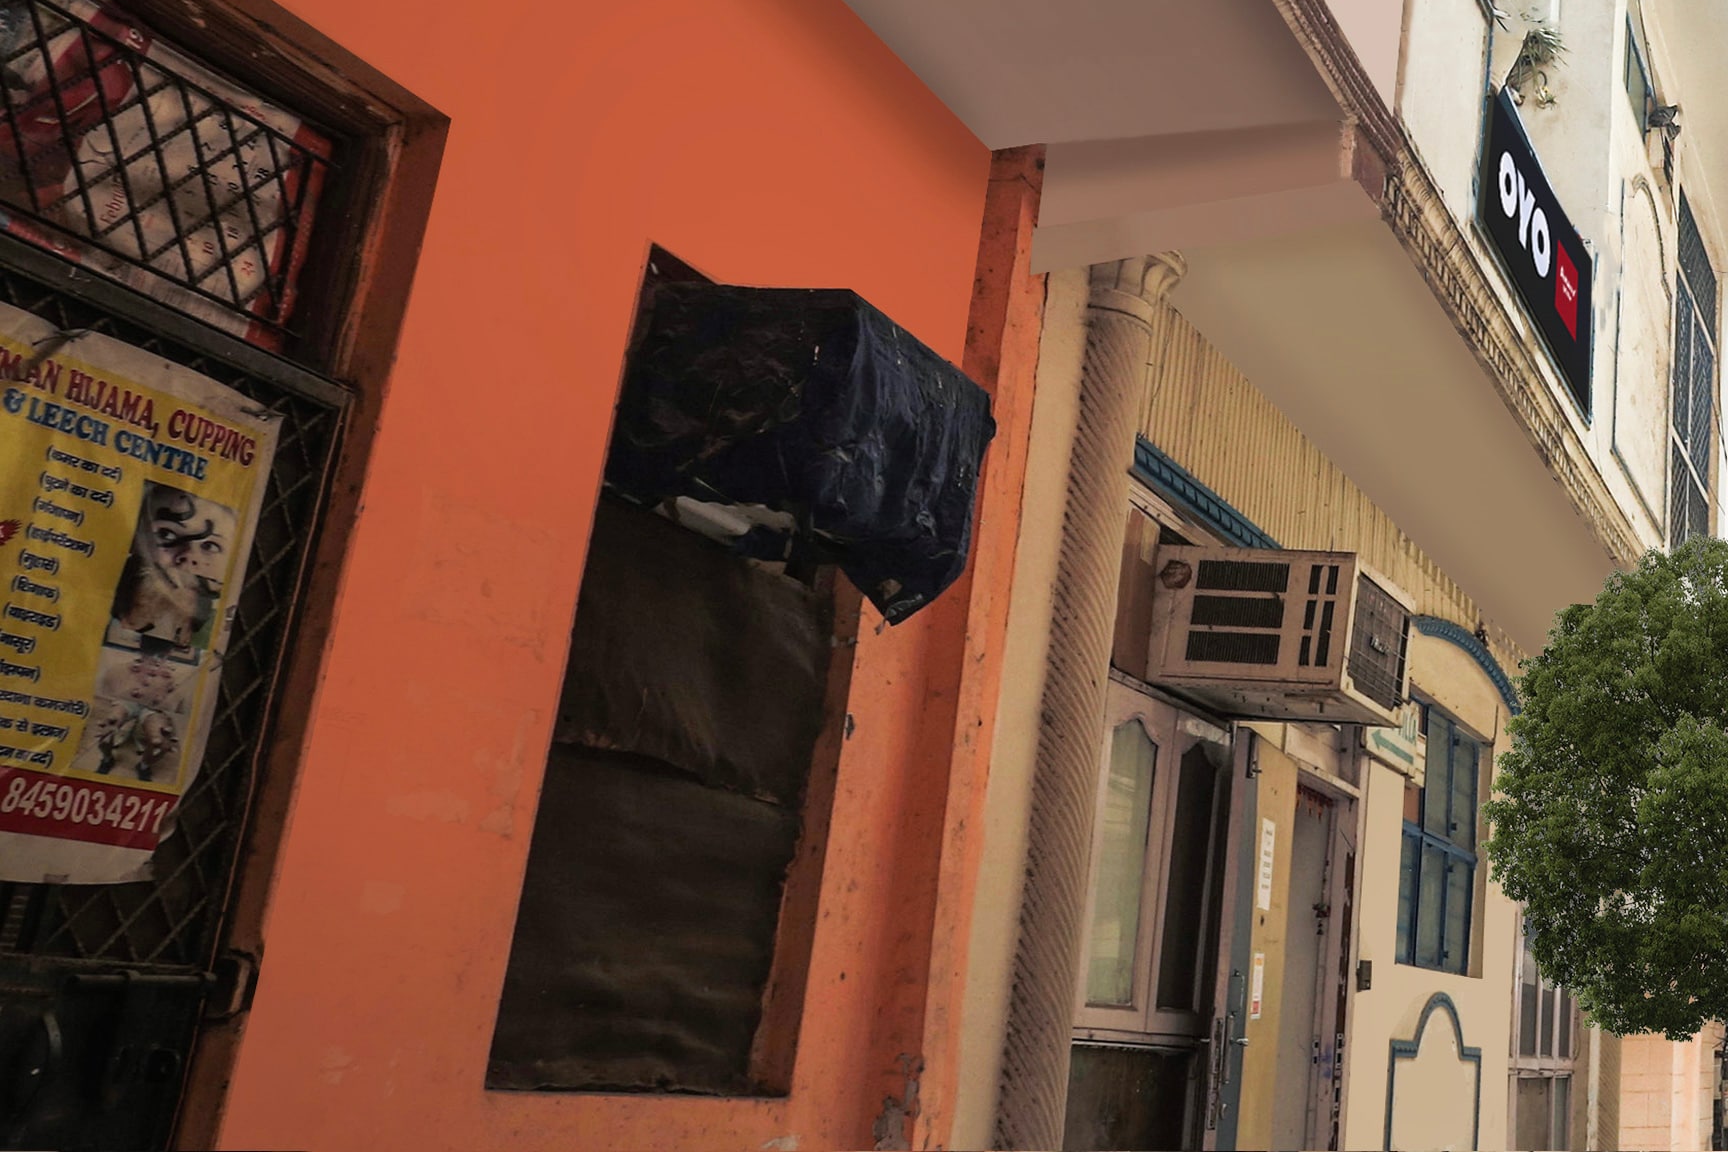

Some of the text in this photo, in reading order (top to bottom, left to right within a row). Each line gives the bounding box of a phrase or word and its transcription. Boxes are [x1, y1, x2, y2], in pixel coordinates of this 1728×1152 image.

[202, 240, 216, 256] 10
[1499, 151, 1551, 278] OYO
[3, 387, 209, 482] & LEECH CENTRE
[64, 368, 160, 438] HIJAMA,
[168, 408, 256, 468] CUPPING
[1, 776, 169, 834] 8459034211
